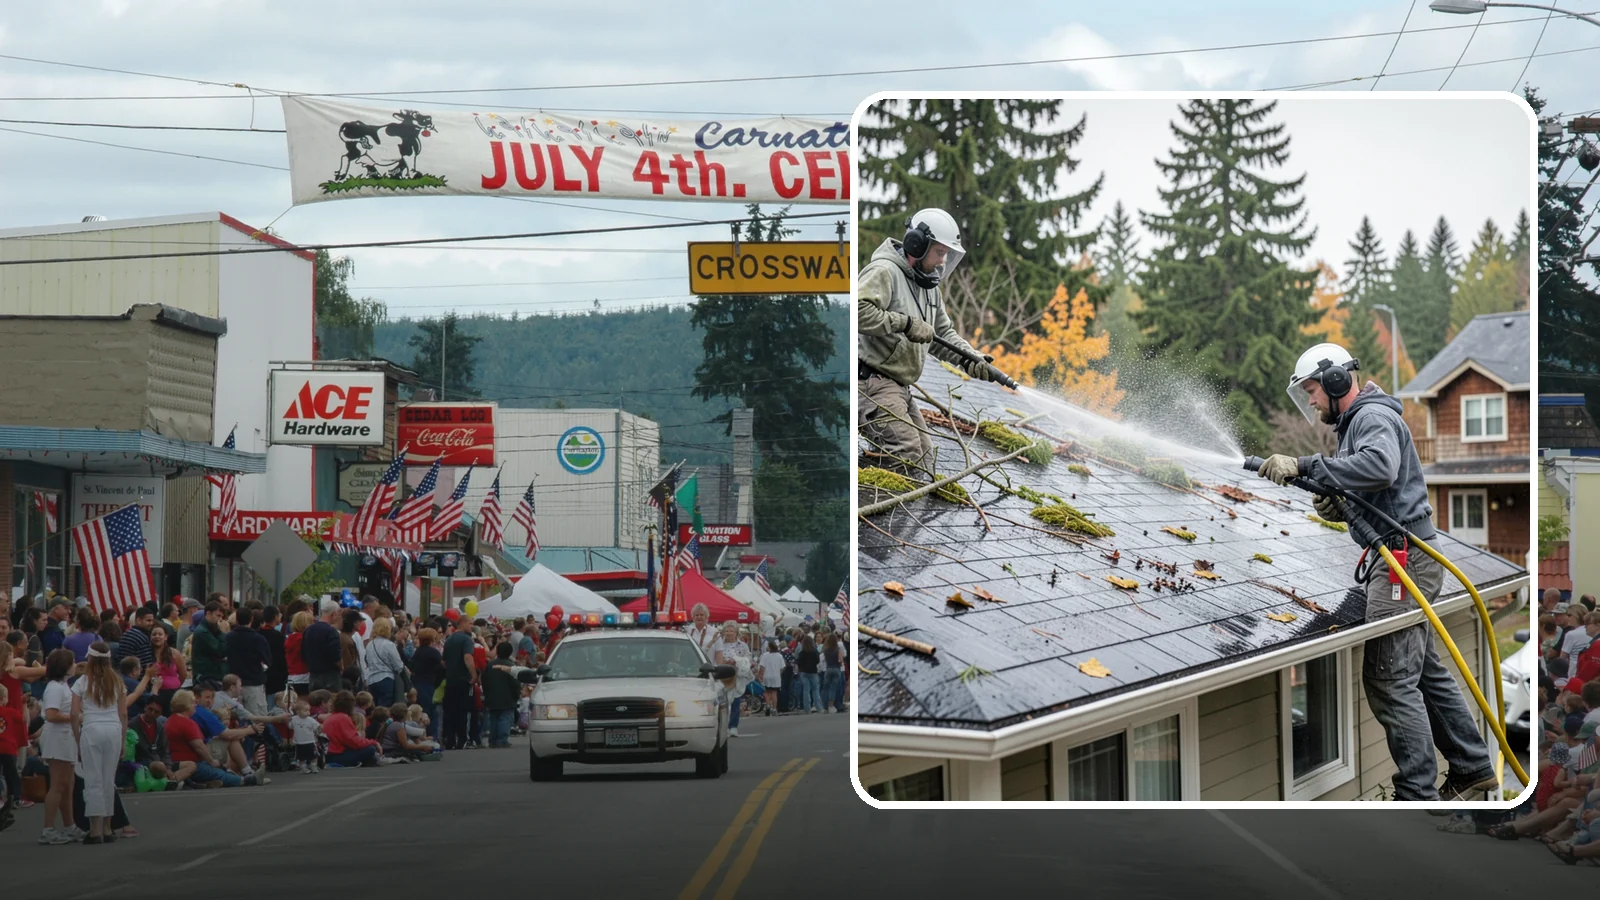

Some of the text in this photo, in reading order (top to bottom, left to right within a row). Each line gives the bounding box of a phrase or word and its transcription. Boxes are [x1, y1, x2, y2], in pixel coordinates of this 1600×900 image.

[481, 141, 605, 192] JULY
[632, 150, 746, 198] 4th.
[696, 254, 850, 280] CROSSWA
[283, 380, 373, 420] ACE
[406, 409, 485, 422] CEDAR LOG
[283, 421, 370, 436] Hardware
[416, 428, 477, 447] Coca-Cola
[83, 485, 155, 495] St. Vincent de Paul
[212, 516, 330, 535] HARDARE
[688, 526, 741, 535] CRNATION
[699, 535, 730, 544] GLASS
